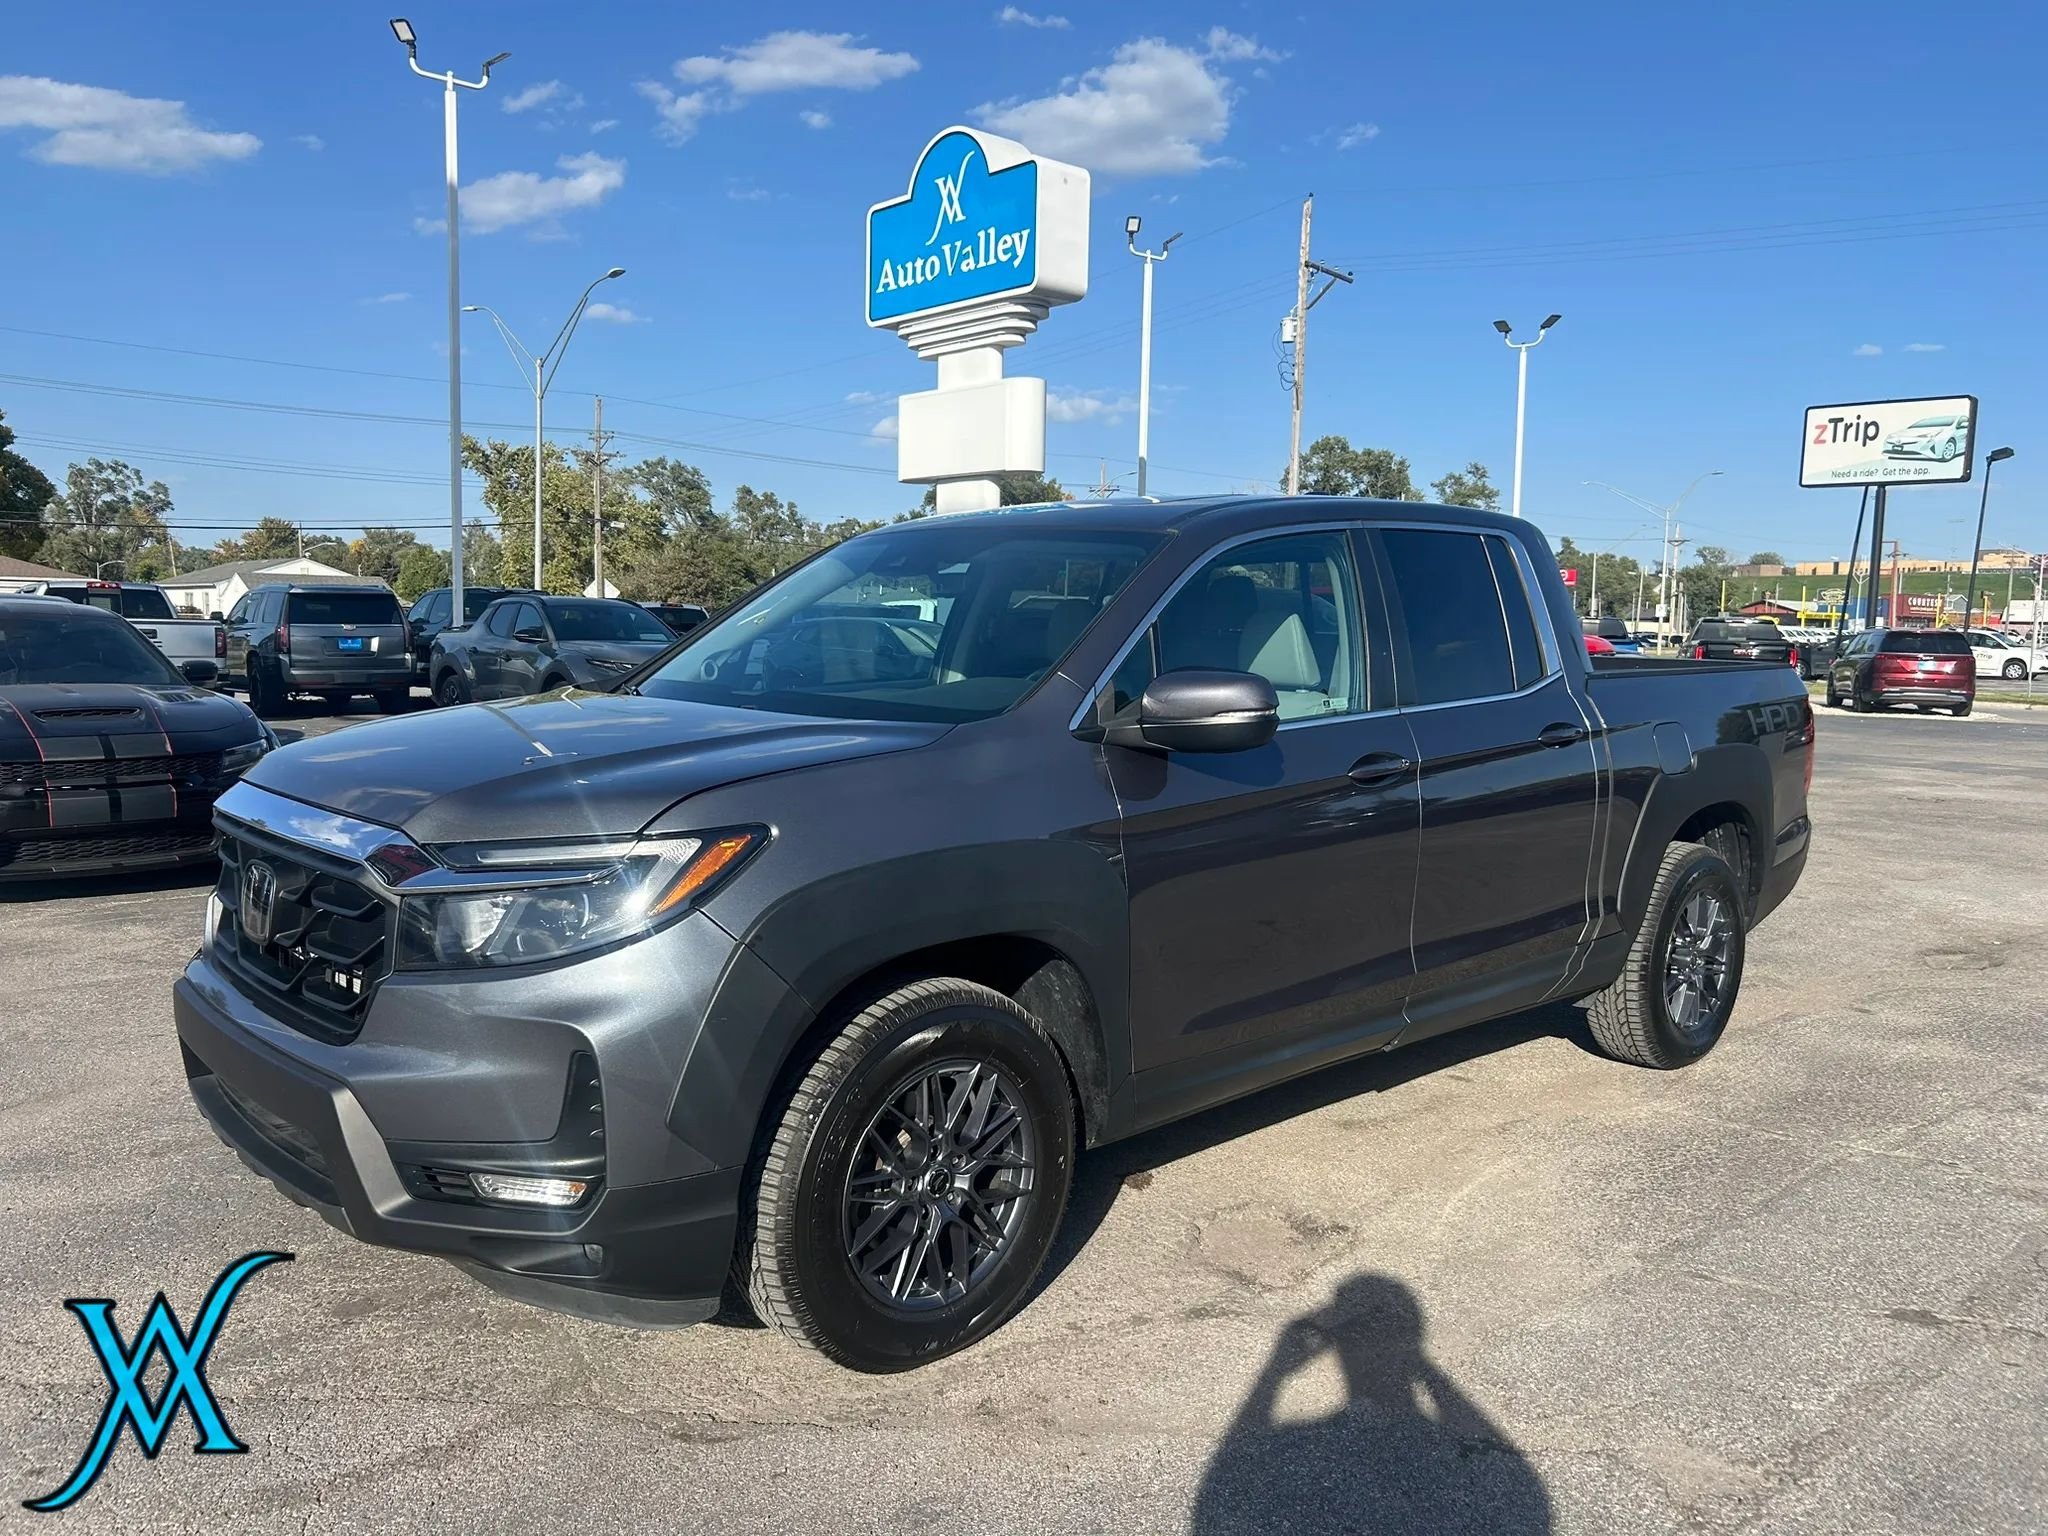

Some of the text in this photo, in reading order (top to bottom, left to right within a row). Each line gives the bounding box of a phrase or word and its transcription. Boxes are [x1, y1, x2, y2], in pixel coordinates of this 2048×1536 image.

[1813, 414, 1880, 447] zTrip
[1831, 470, 1851, 478] Need
[1859, 469, 1879, 477] ride?
[1882, 468, 1896, 476] Get
[1899, 467, 1911, 475] the
[1913, 468, 1931, 476] app.
[1747, 703, 1800, 736] HPD
